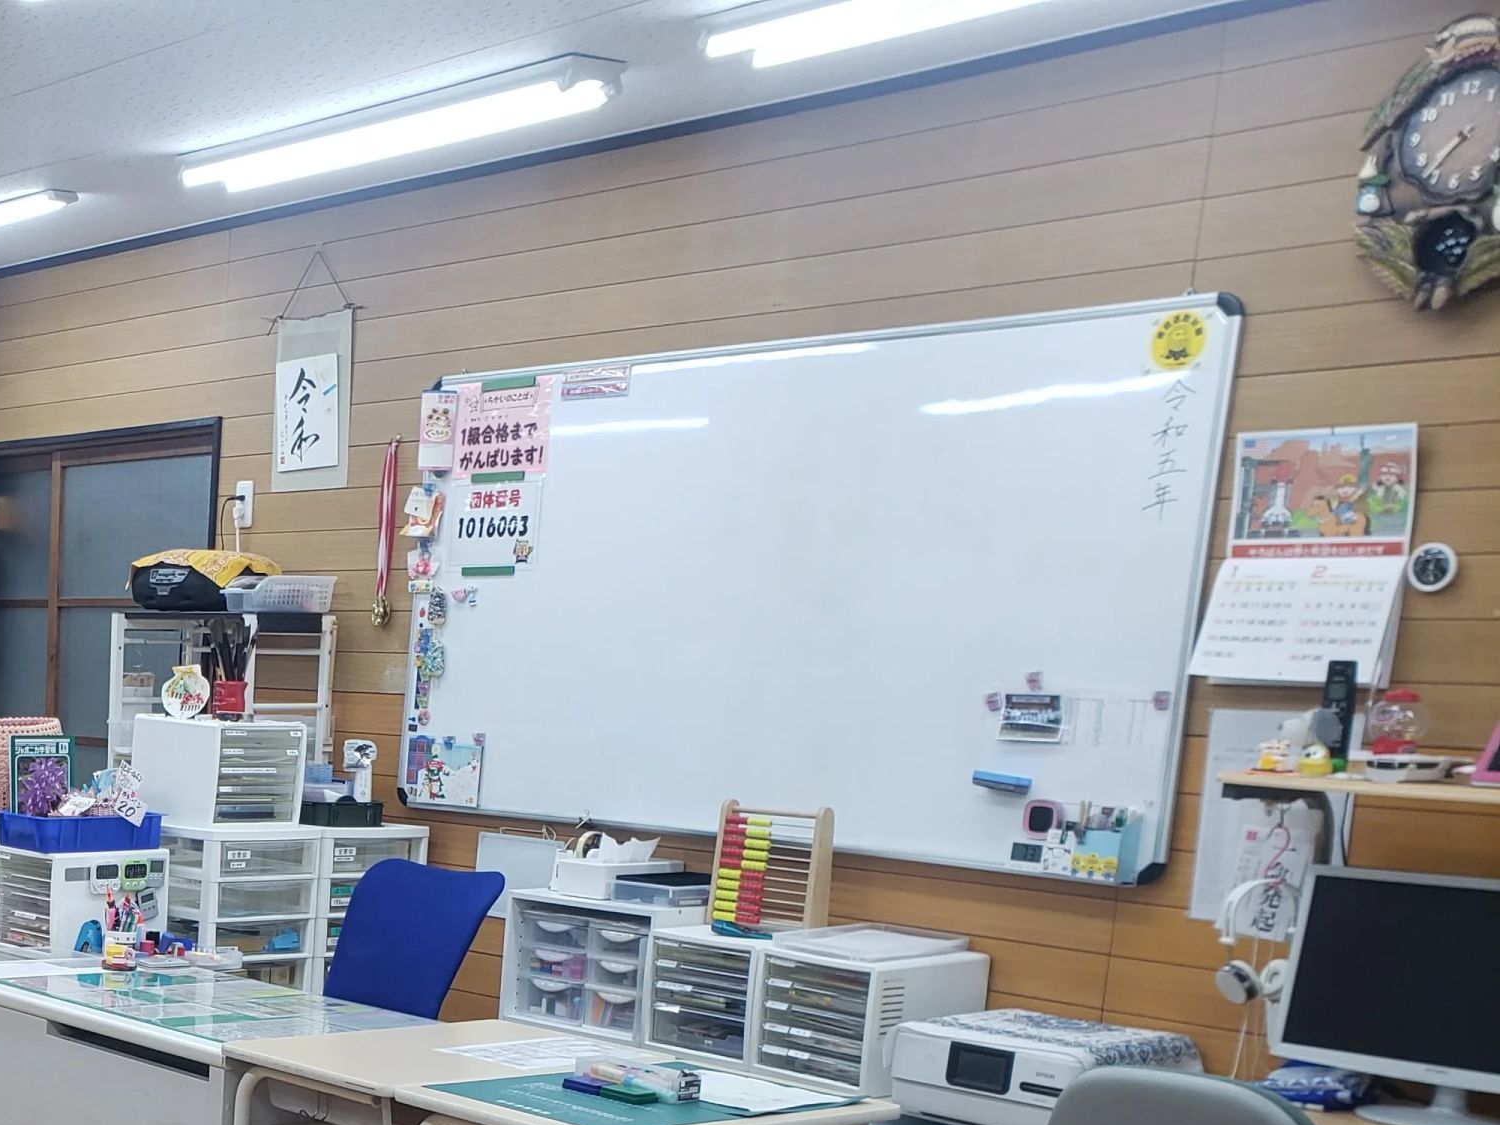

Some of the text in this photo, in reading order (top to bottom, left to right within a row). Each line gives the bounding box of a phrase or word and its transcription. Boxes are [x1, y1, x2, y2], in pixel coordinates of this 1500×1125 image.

[1462, 80, 1480, 95] 12
[1487, 88, 1495, 102] 1
[1441, 92, 1456, 106] 11
[1421, 107, 1438, 122] 10
[1409, 132, 1421, 148] 9
[1415, 152, 1428, 167] 8
[1448, 174, 1460, 189] 6
[289, 367, 320, 462] 令和
[461, 421, 538, 446] 1級合格まで
[1141, 379, 1197, 521] 令和五年
[469, 488, 522, 509] 団体番号
[457, 515, 530, 539] 1016003
[117, 799, 136, 818] 20
